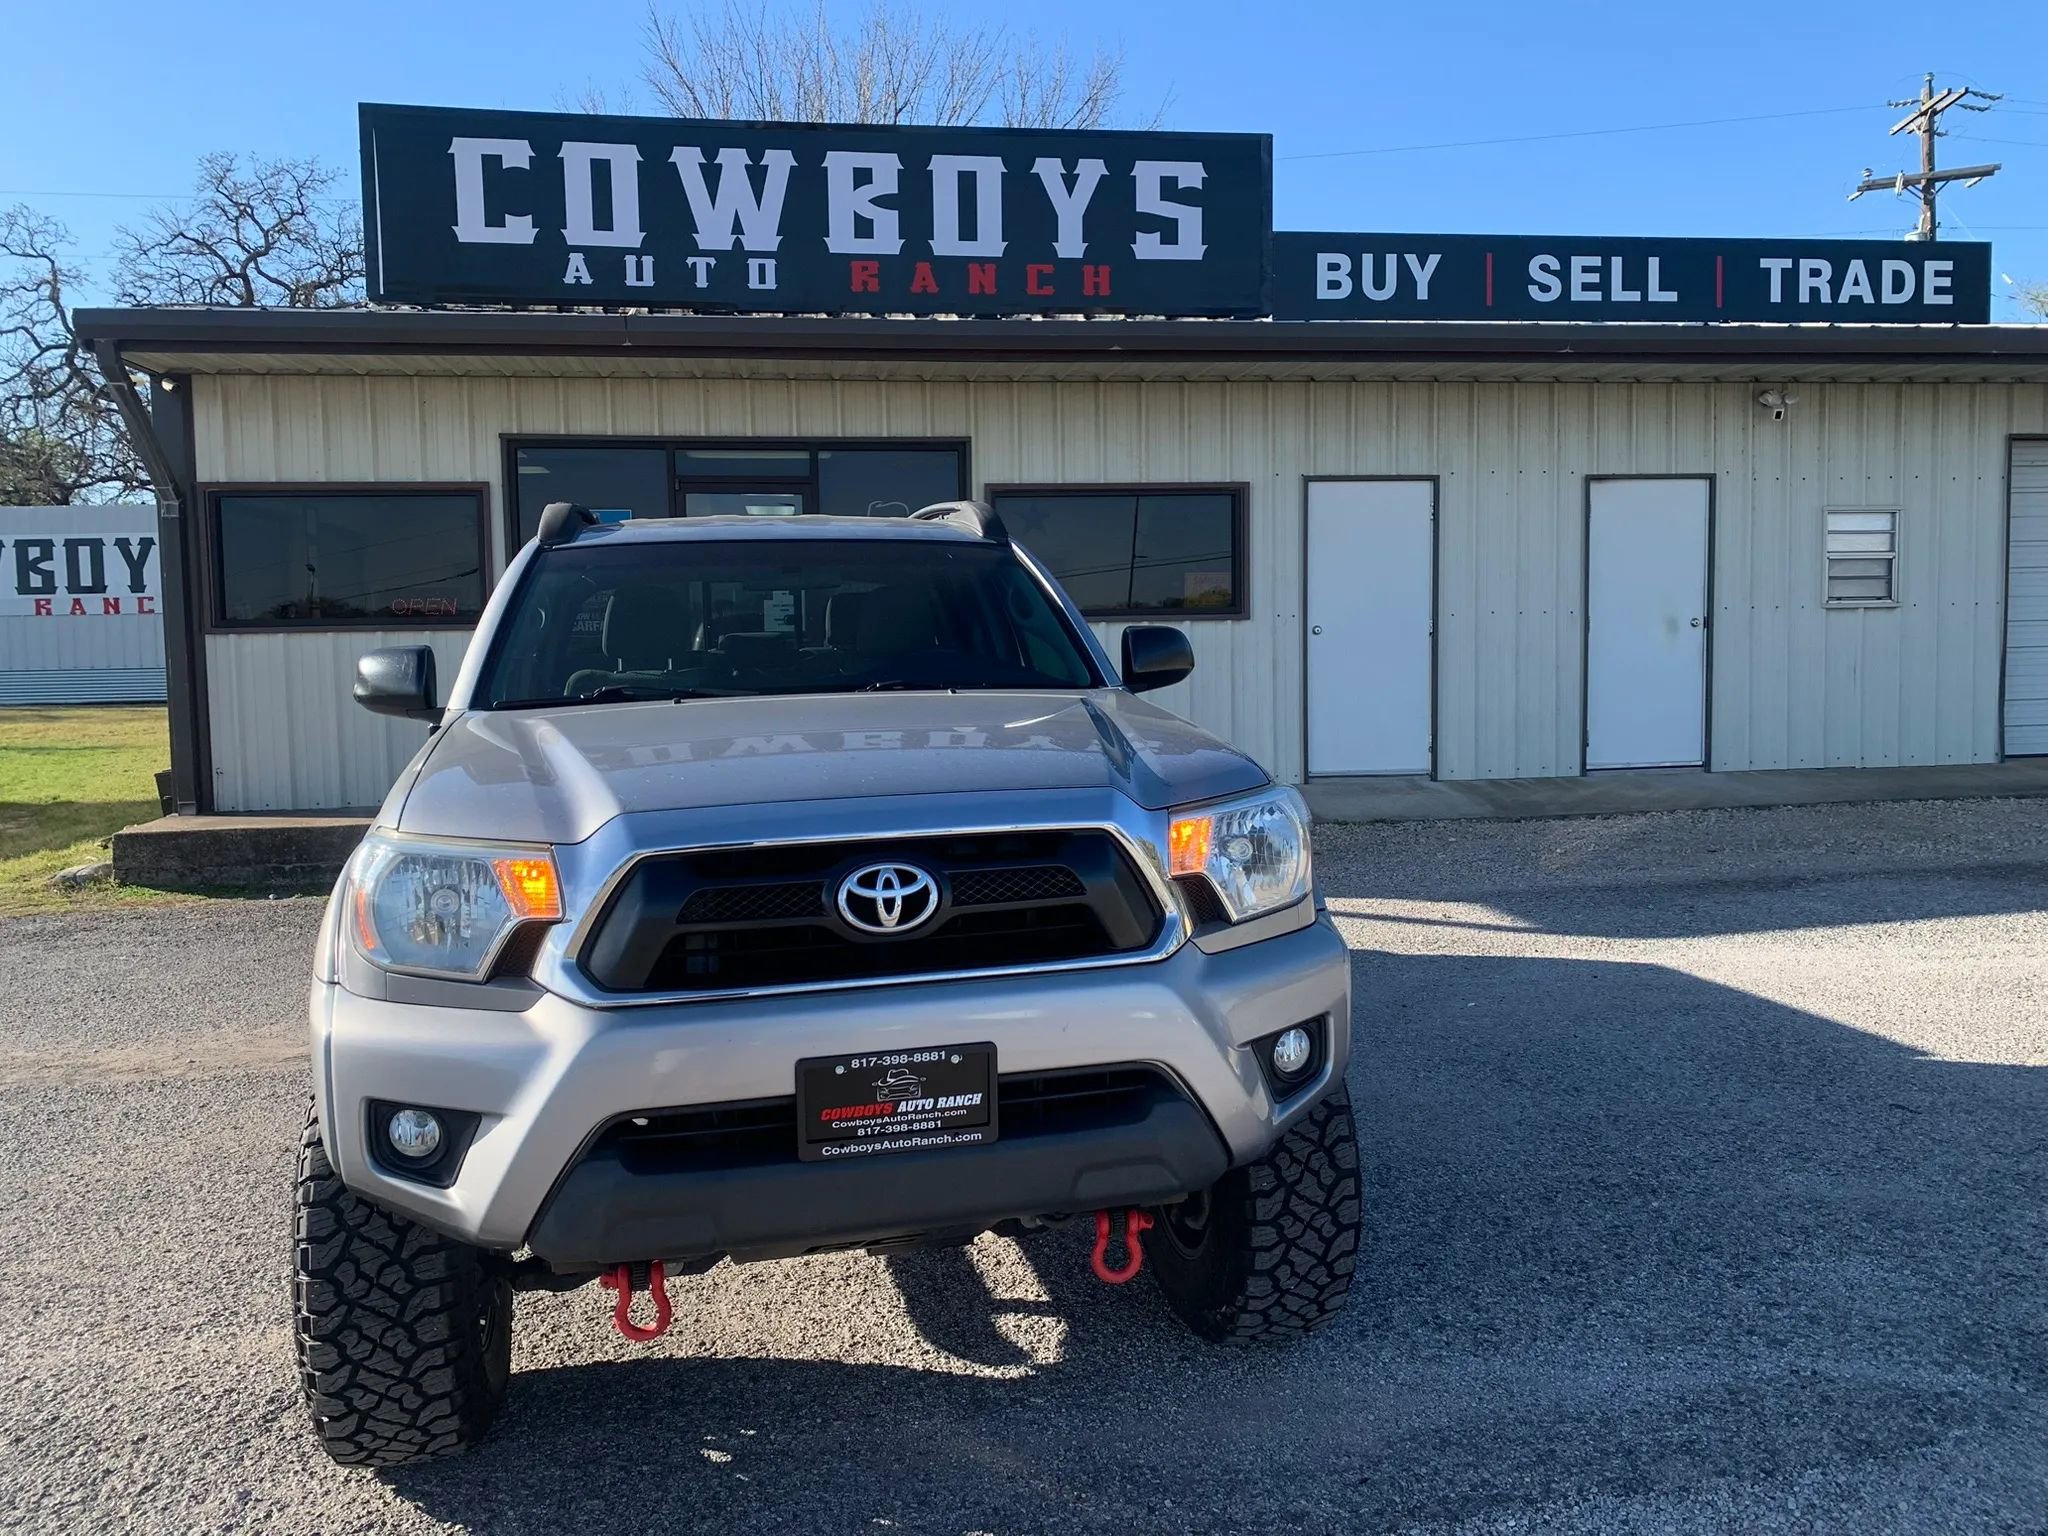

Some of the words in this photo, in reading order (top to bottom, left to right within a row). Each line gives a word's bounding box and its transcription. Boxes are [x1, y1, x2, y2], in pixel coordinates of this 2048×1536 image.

[448, 136, 1207, 261] COWBOYS
[563, 250, 778, 290] AUTO
[850, 261, 1111, 296] RANCH
[1316, 252, 1442, 301] BUY
[1527, 254, 1678, 302] SELL
[1760, 257, 1955, 305] TRADE
[0, 537, 156, 595] BOY
[392, 598, 458, 615] OPEN
[850, 1050, 946, 1069] 817-398-8881
[821, 1102, 894, 1121] COWBOYS
[897, 1098, 934, 1113] AUTO
[937, 1093, 983, 1109] RANCH
[831, 1108, 967, 1129] CowboysAutoRanch.com
[857, 1120, 943, 1137] 817-398-8881
[821, 1131, 982, 1156] CowboysAutoRanch.com
